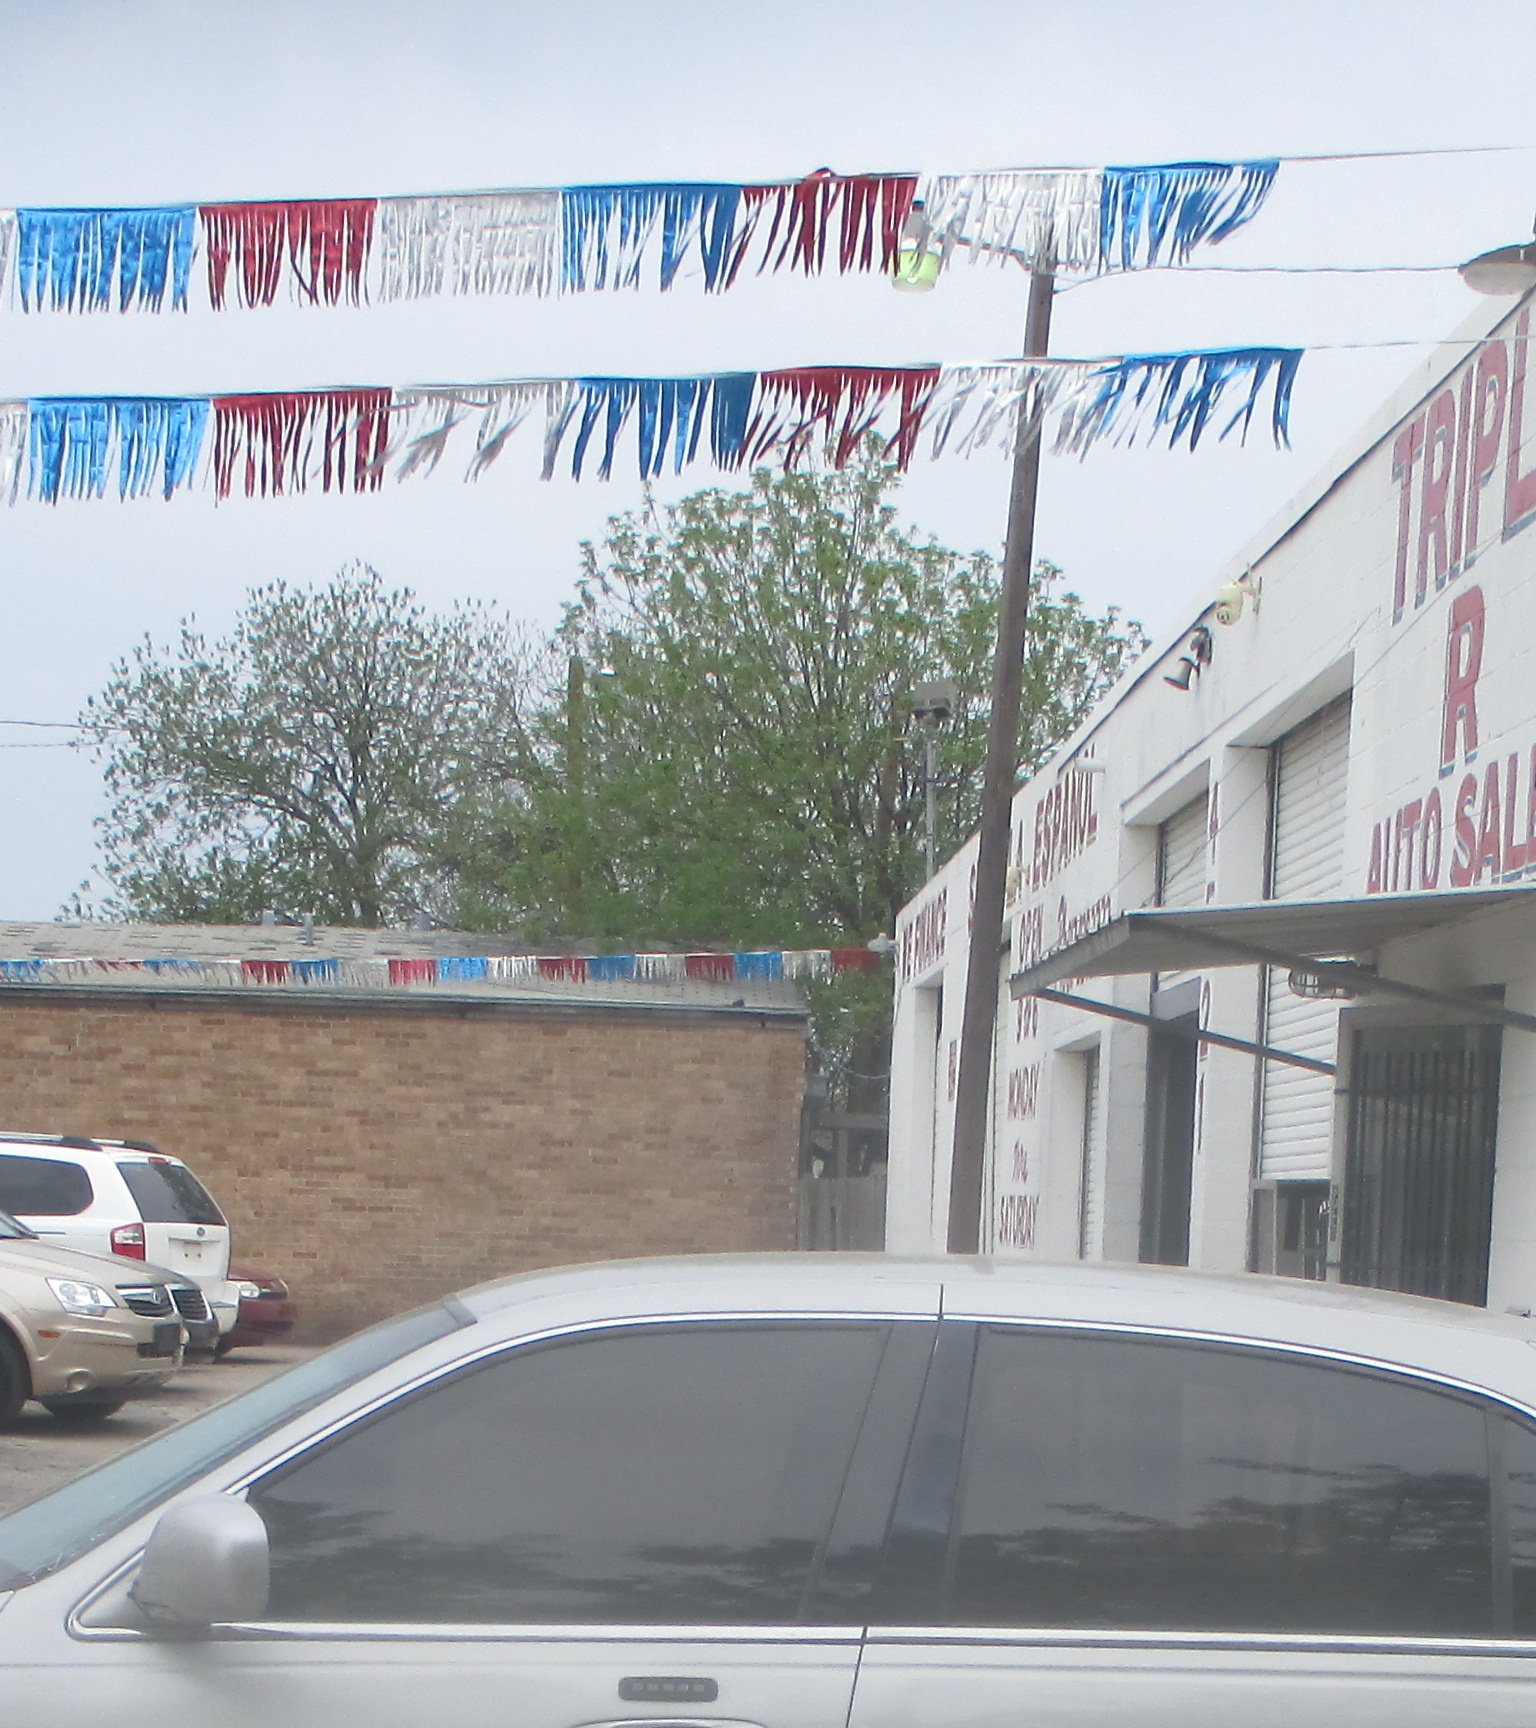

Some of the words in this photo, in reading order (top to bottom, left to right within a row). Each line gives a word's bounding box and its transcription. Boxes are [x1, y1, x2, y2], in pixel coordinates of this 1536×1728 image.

[1439, 585, 1485, 779] R
[1367, 786, 1442, 894] AUTO
[1020, 903, 1044, 968] OPEN
[1007, 1061, 1040, 1121] MONDAY
[999, 1192, 1040, 1250] SATURDAY
